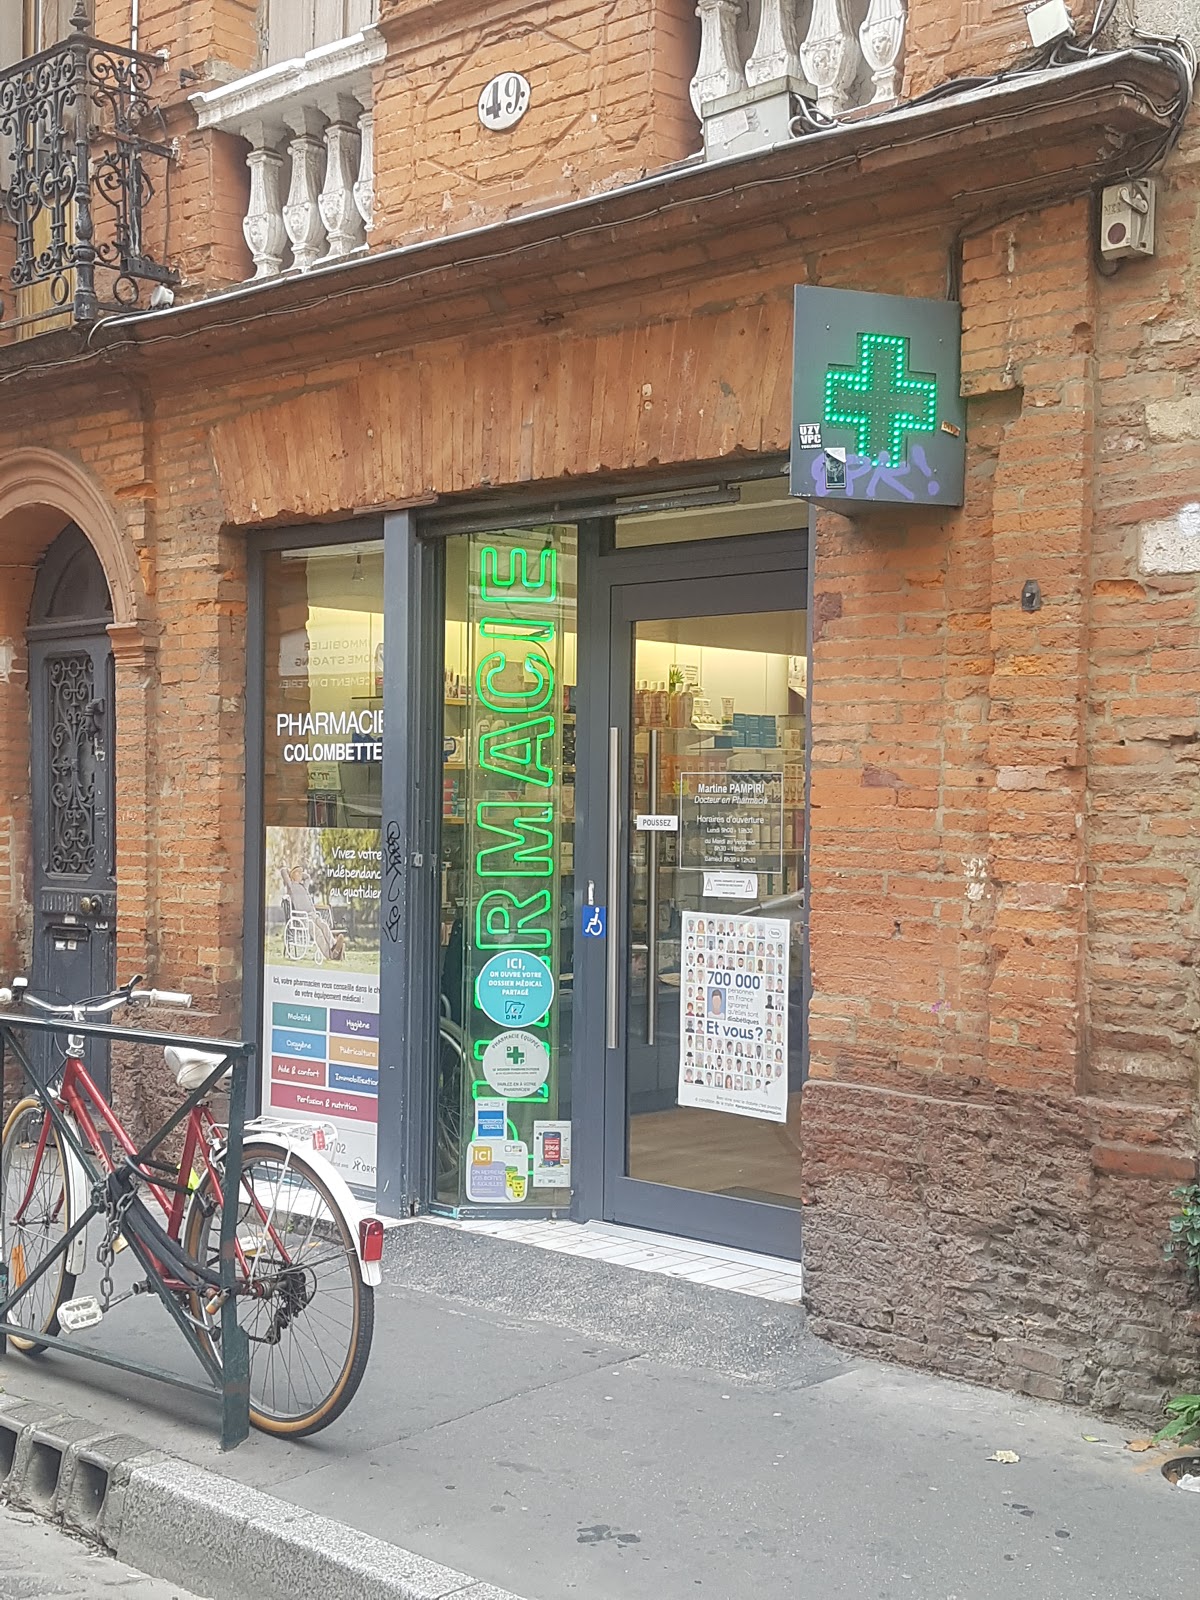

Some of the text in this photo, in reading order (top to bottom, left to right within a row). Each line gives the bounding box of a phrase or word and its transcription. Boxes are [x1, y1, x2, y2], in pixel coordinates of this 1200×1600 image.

[799, 426, 820, 435] UZY
[800, 434, 822, 445] VPC
[283, 742, 383, 762] COLOMBETTE
[698, 784, 765, 794] Martine PAMPIRI
[694, 795, 721, 804] Docteur
[642, 818, 672, 827] POUSSEZ
[696, 815, 765, 825] Horaires d'ouverture
[331, 847, 382, 860] Vivez votre
[327, 864, 382, 884] indépendanc
[330, 887, 341, 896] au
[506, 957, 526, 971] ICI,
[515, 979, 543, 988] MÉDICAL
[706, 970, 732, 987] 700
[281, 978, 292, 986] votre
[293, 979, 320, 989] pharmacien
[355, 985, 367, 993] dans
[314, 990, 341, 1001] équipement
[342, 995, 361, 1003] médical
[501, 988, 529, 996] PARTAGÉ
[287, 1012, 312, 1023] Mobilité
[346, 1019, 370, 1032] Hygiène
[706, 1020, 720, 1036] Et
[722, 1025, 755, 1040] vous
[277, 1064, 291, 1075] Aide
[297, 1068, 320, 1078] confort
[296, 1094, 324, 1106] Perfusion
[331, 1102, 358, 1112] nutrition
[474, 1150, 492, 1161] ICI
